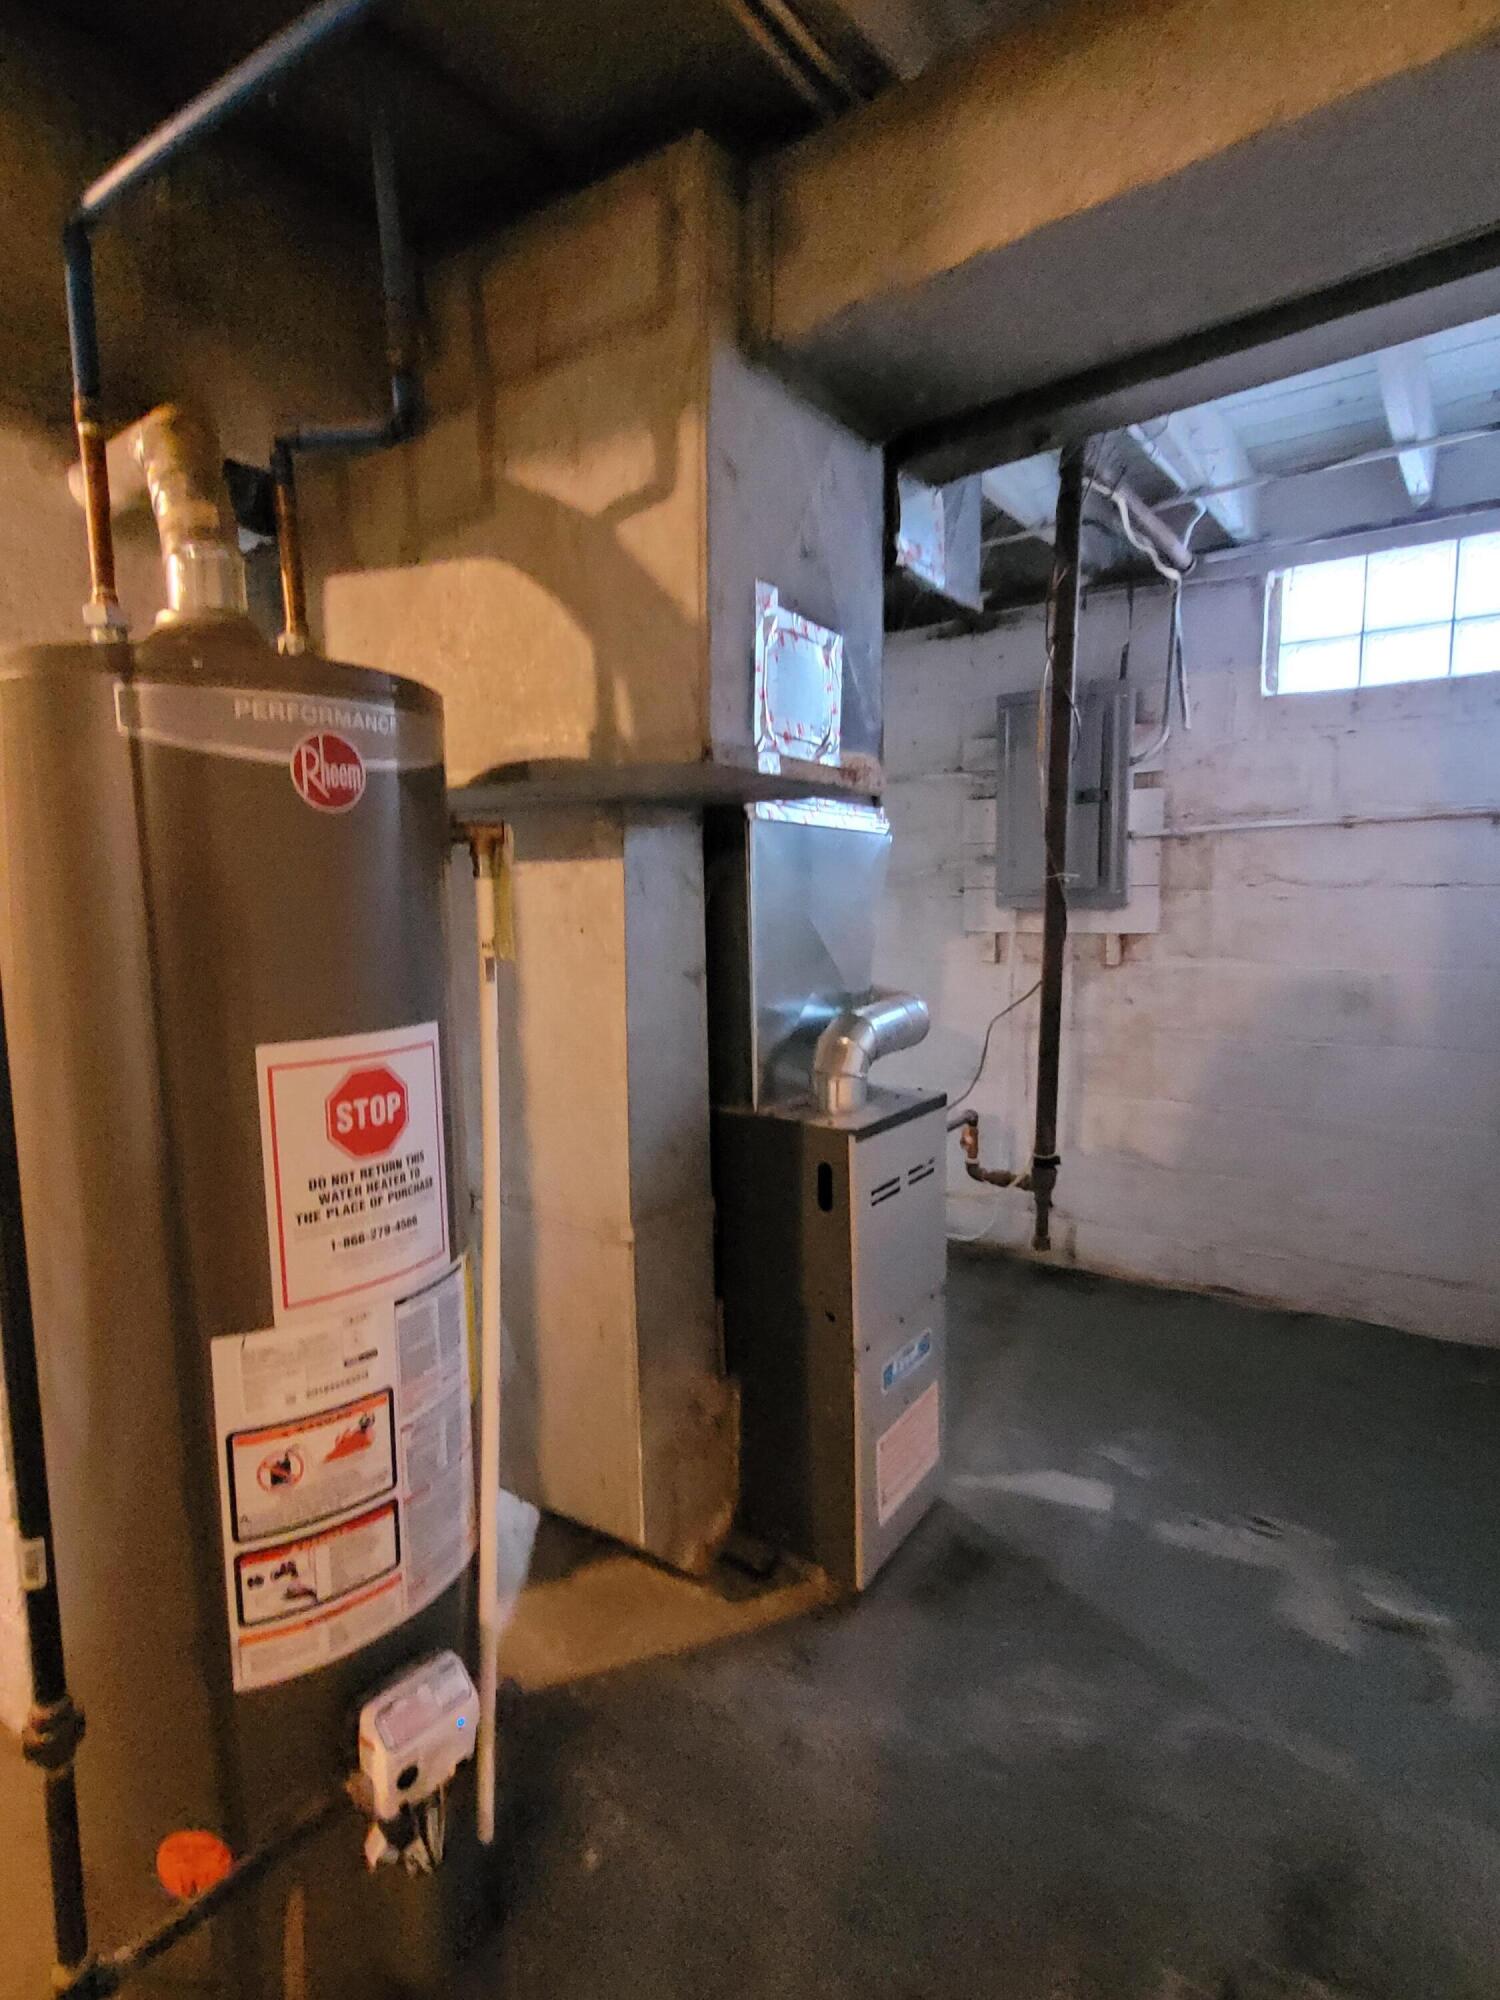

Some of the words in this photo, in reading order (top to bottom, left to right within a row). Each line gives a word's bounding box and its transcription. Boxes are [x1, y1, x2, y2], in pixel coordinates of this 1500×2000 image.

[300, 734, 362, 800] Rheem
[335, 1091, 402, 1134] STOP
[308, 1177, 327, 1192] DO
[331, 1170, 355, 1187] NOT
[359, 1157, 403, 1181] RETURN
[406, 1149, 425, 1167] THIS
[318, 1184, 362, 1206] WATER
[365, 1172, 406, 1194] HEATER
[409, 1166, 421, 1181] TO
[296, 1210, 320, 1227] THE
[326, 1199, 366, 1220] PLACE
[369, 1195, 384, 1209] OF
[387, 1175, 433, 1205] PURCHASE
